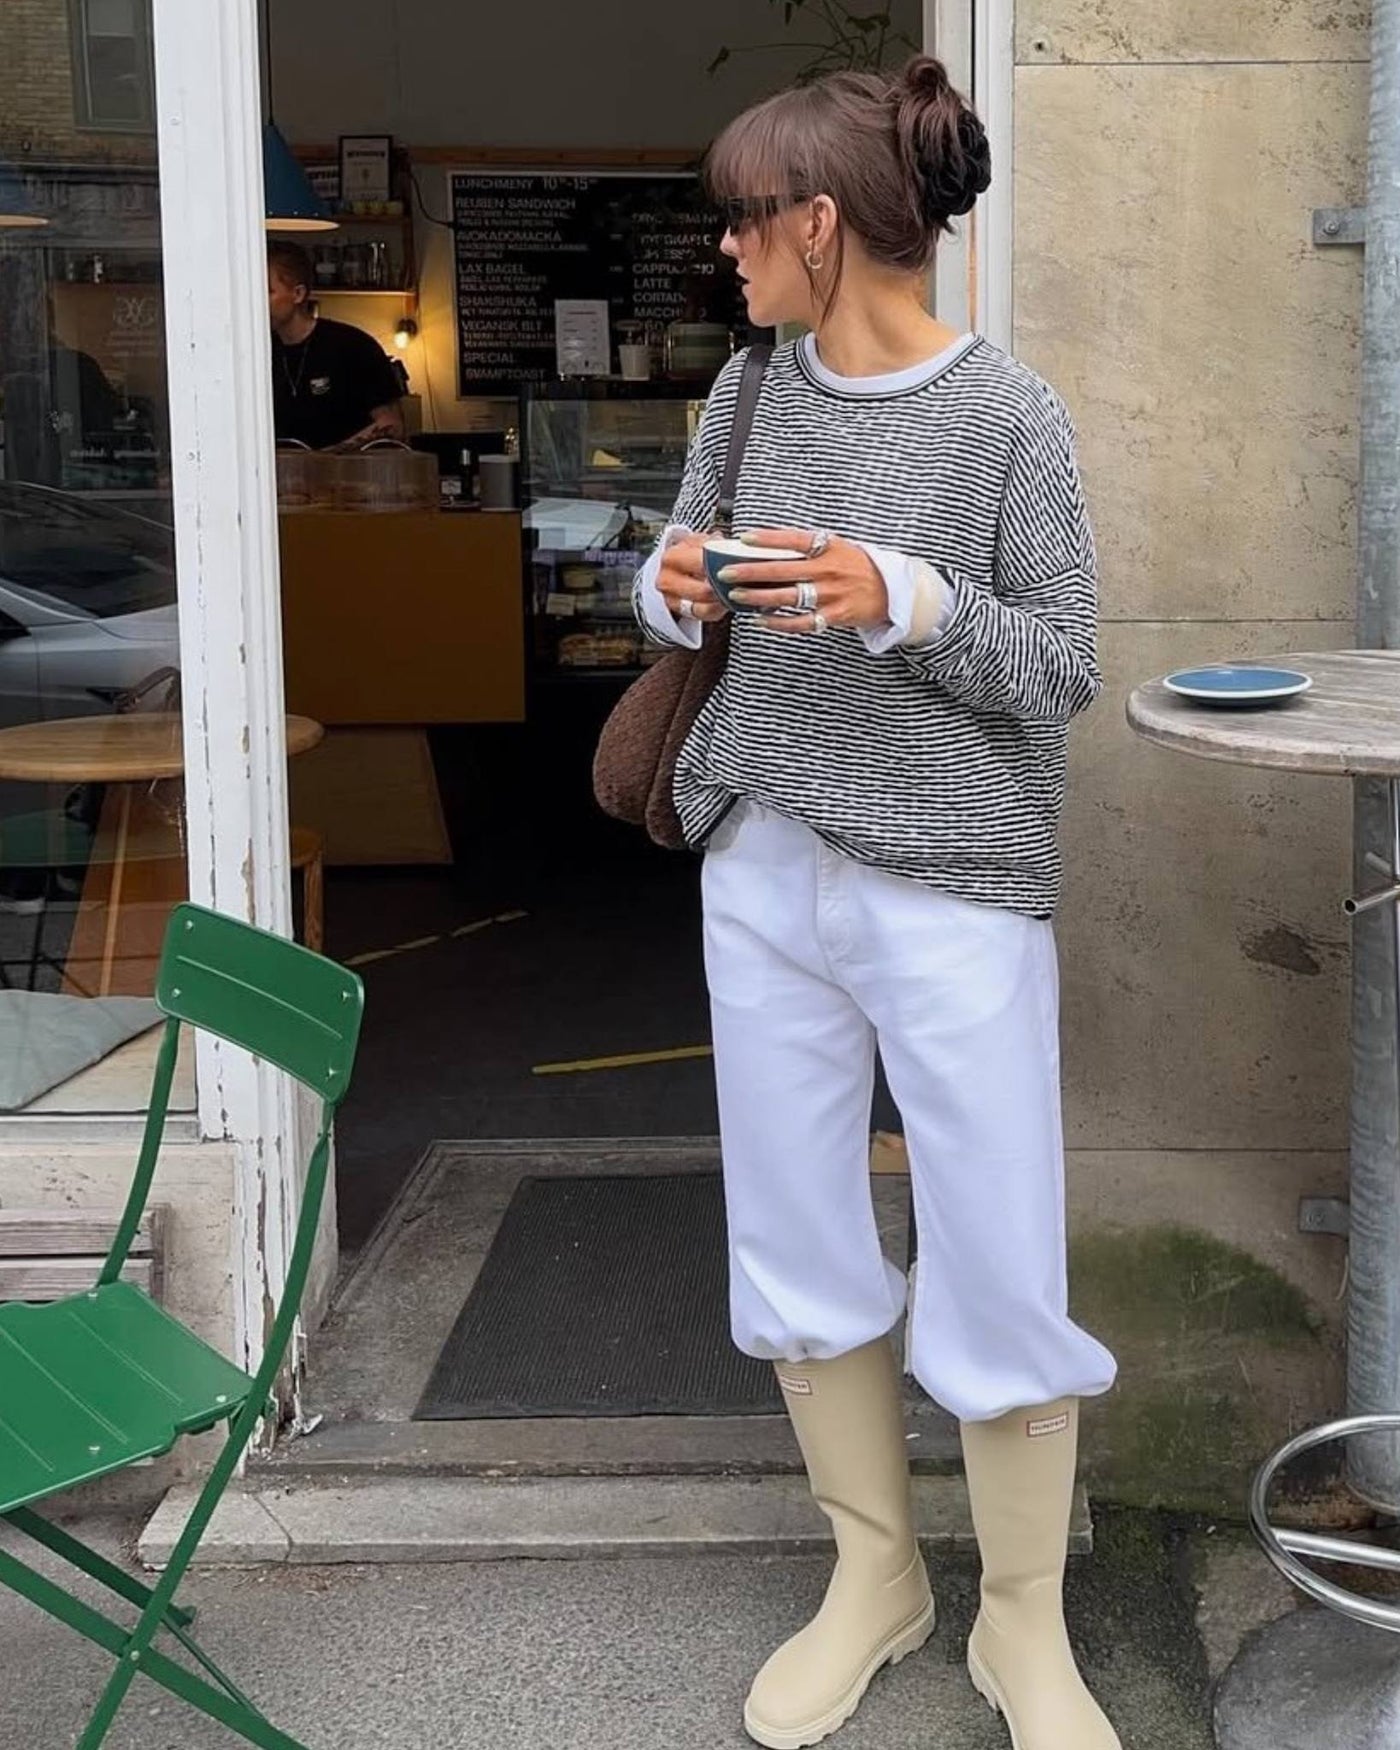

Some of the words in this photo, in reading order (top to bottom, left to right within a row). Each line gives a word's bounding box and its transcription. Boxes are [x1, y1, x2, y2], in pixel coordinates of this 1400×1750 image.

[454, 178, 535, 189] LUNCHMENY
[455, 197, 505, 209] REUBEN
[507, 198, 577, 209] SANDWICH
[458, 263, 483, 274] LAX
[485, 263, 525, 275] BAGEL
[633, 278, 672, 289] LATTE
[521, 320, 542, 332] BLT
[463, 352, 516, 364] SPECIAL
